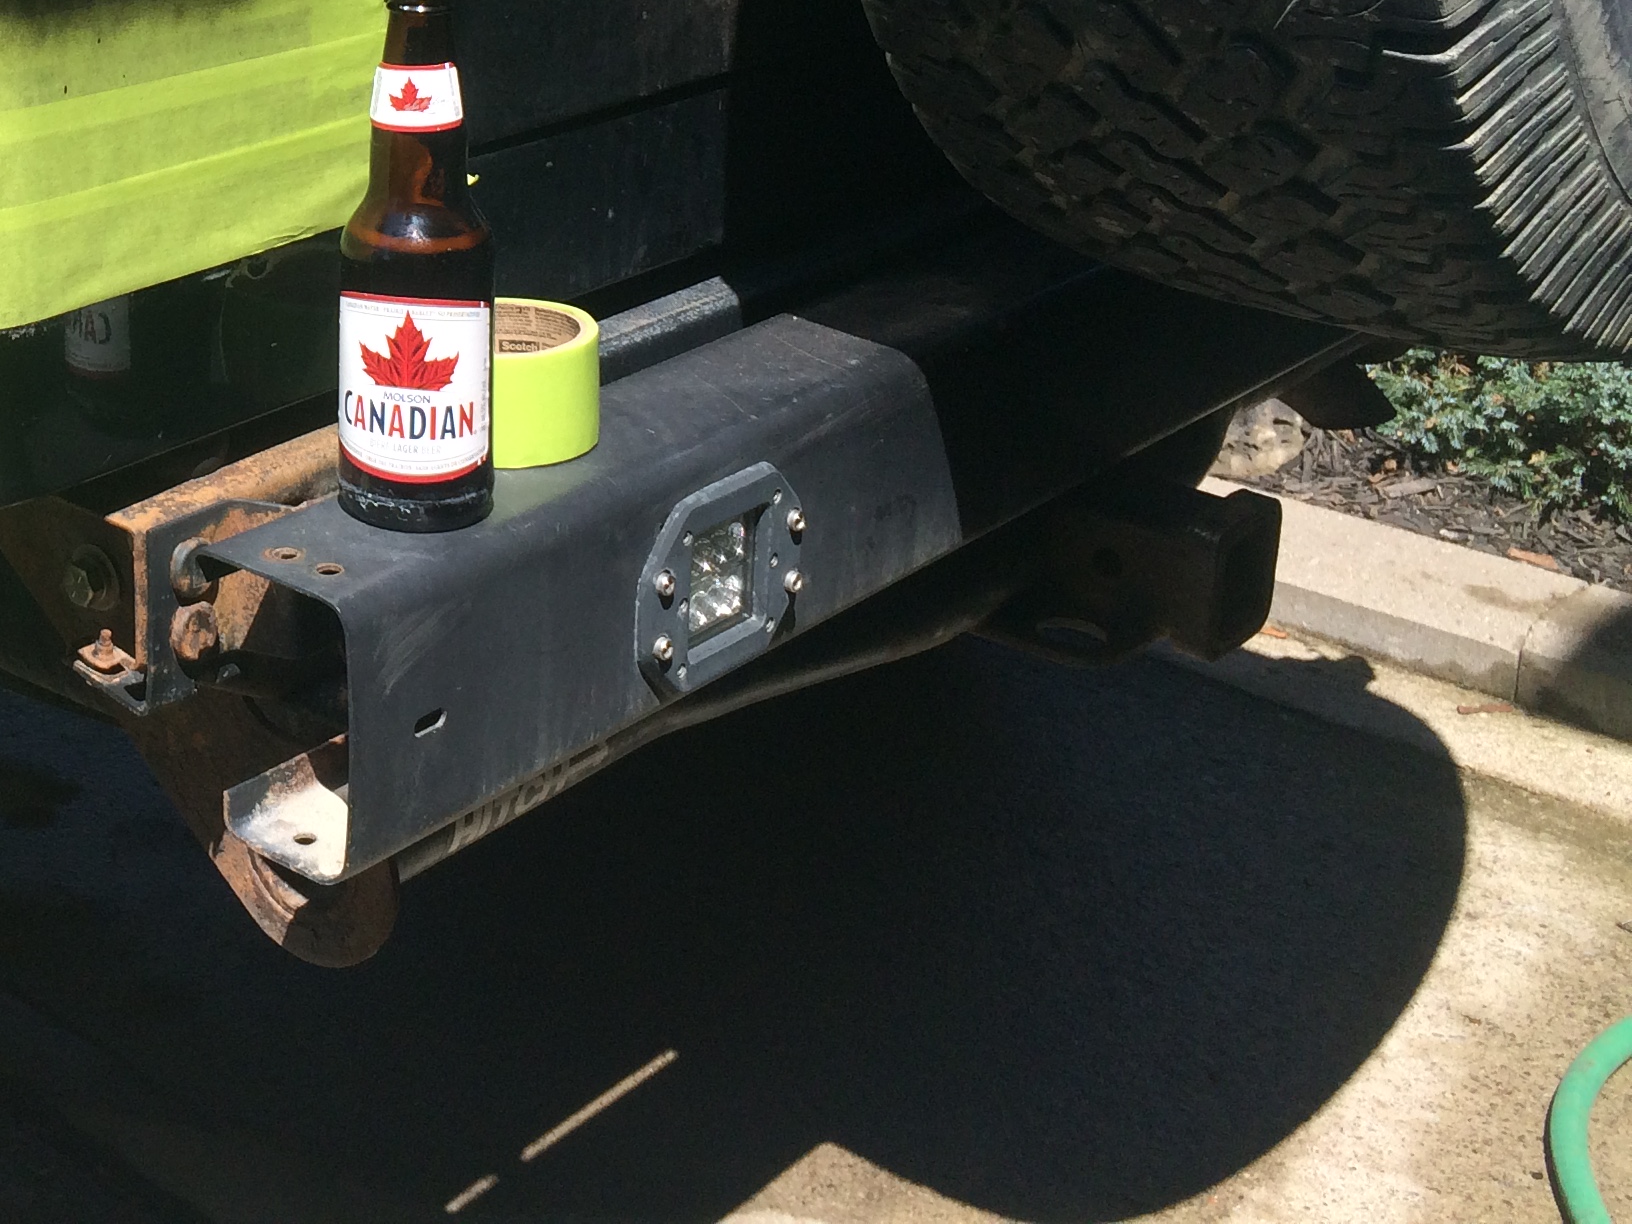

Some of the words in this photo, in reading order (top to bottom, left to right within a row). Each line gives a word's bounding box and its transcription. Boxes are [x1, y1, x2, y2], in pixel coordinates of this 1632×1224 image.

[501, 341, 538, 352] Scotch
[382, 391, 431, 404] MOLSON
[344, 389, 475, 441] CANADIAN
[393, 443, 419, 454] LAGER
